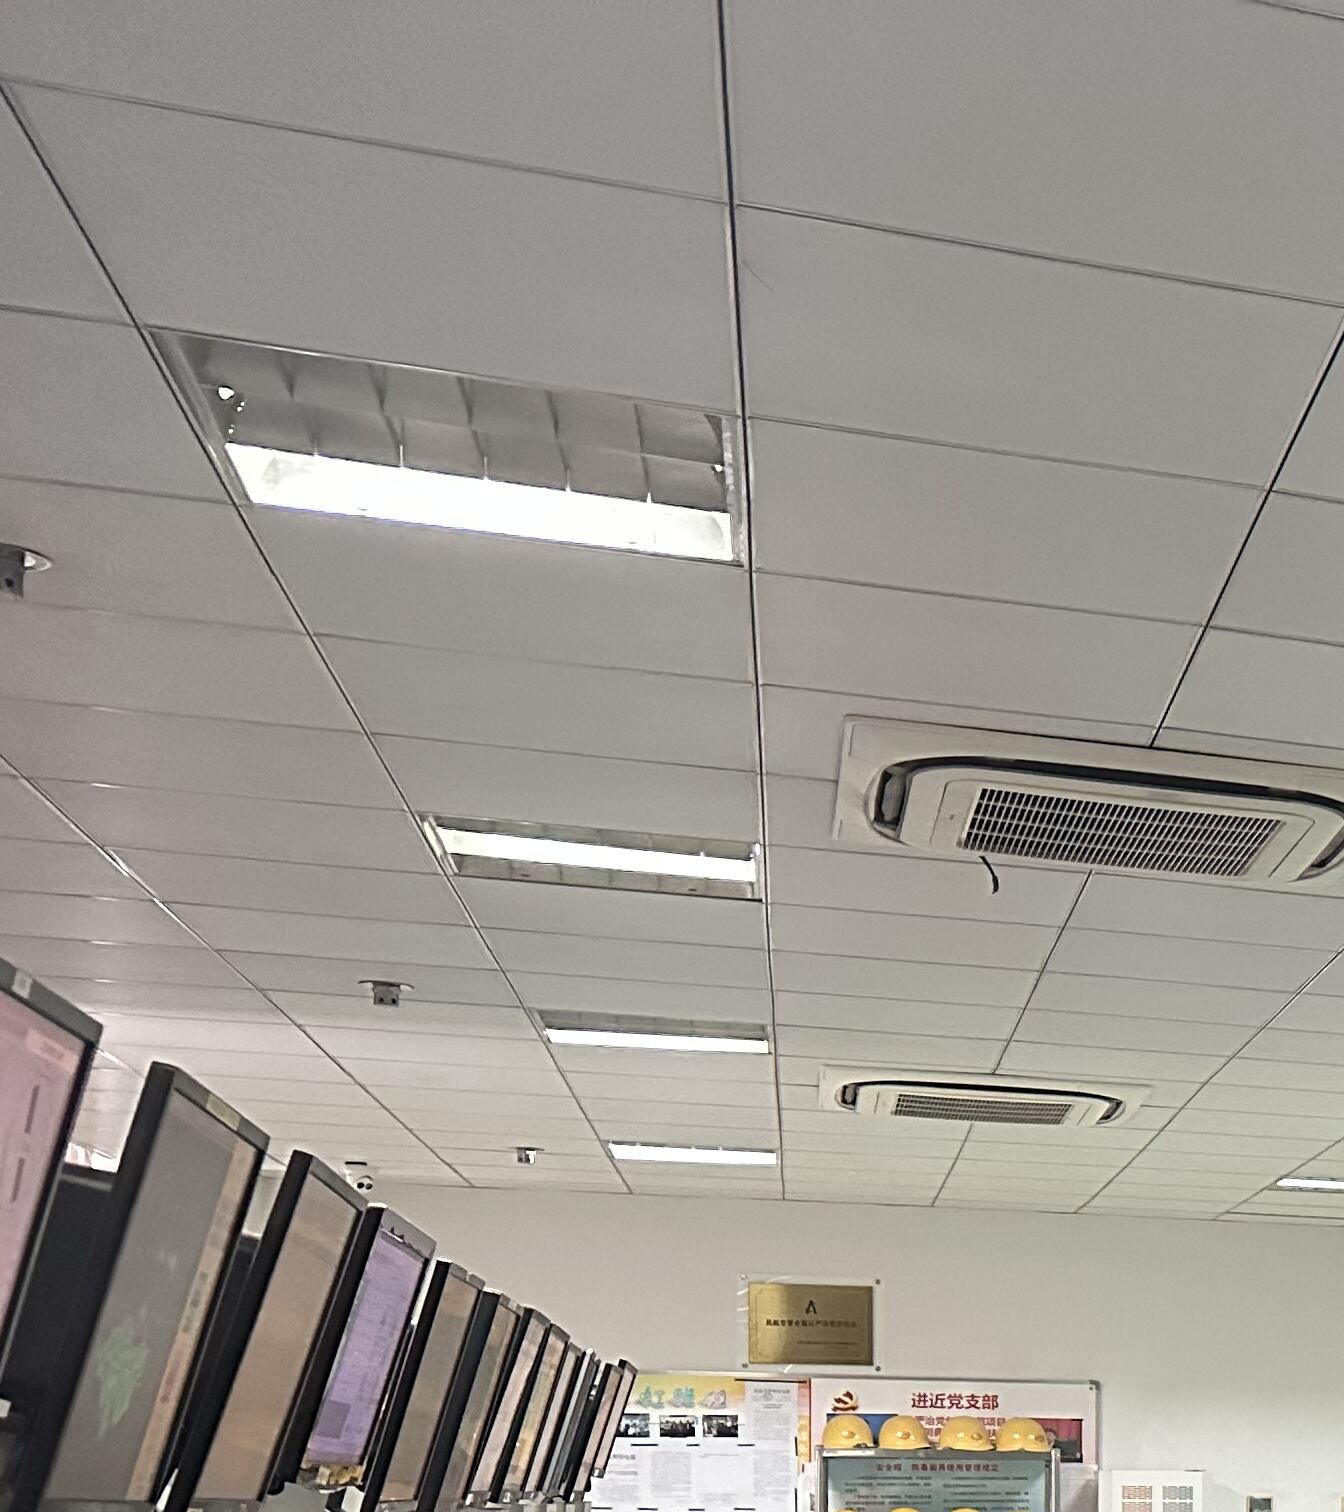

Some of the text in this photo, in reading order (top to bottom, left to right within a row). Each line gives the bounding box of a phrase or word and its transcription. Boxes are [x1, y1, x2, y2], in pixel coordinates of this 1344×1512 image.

[911, 1392, 999, 1411] 进近党支部
